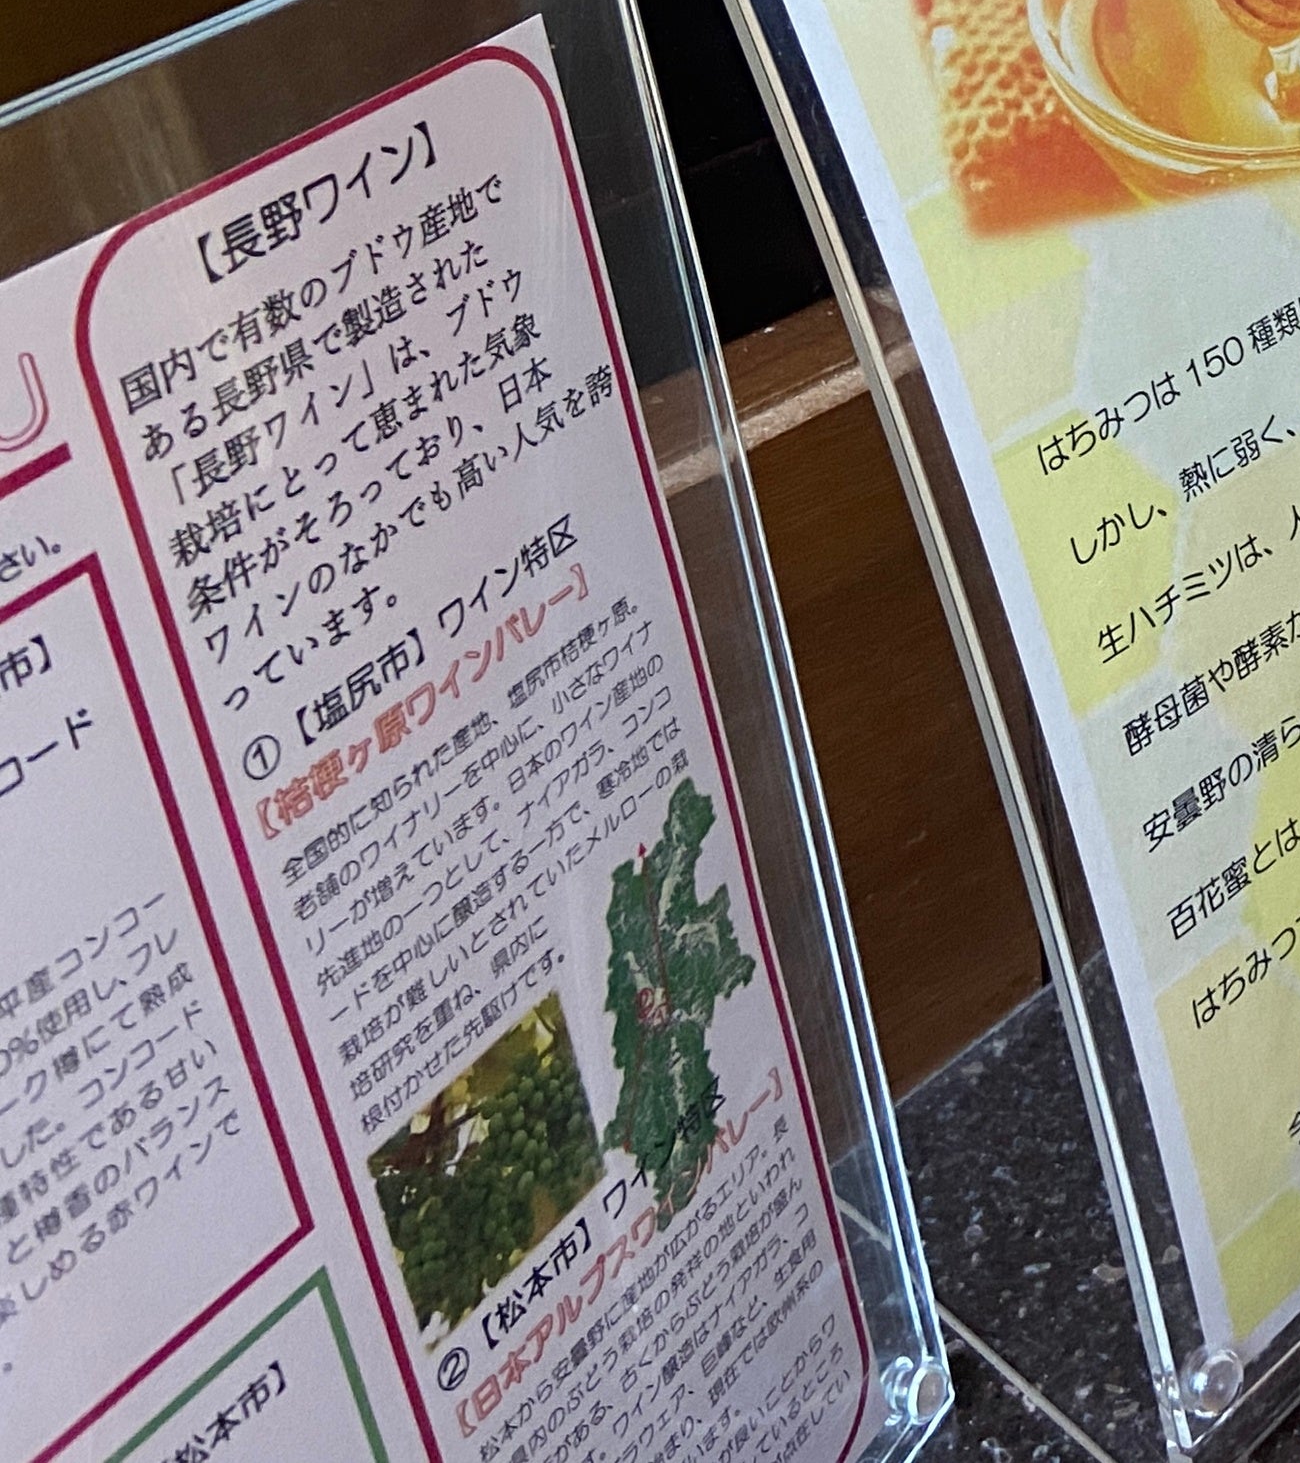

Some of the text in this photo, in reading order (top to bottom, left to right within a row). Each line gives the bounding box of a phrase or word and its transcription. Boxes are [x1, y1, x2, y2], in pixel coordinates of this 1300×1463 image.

[119, 174, 503, 414] 国内で有数のブドウ産地で
[197, 119, 437, 284] 【長野ワイン】
[142, 240, 488, 462] ある長野県で製造された
[169, 313, 541, 568] 栽培にとって恵まれた気象
[186, 357, 553, 623] 条件がそろっており、日本
[203, 365, 616, 663] ワインのなかでも高い人気を誇
[223, 586, 399, 711] っています。
